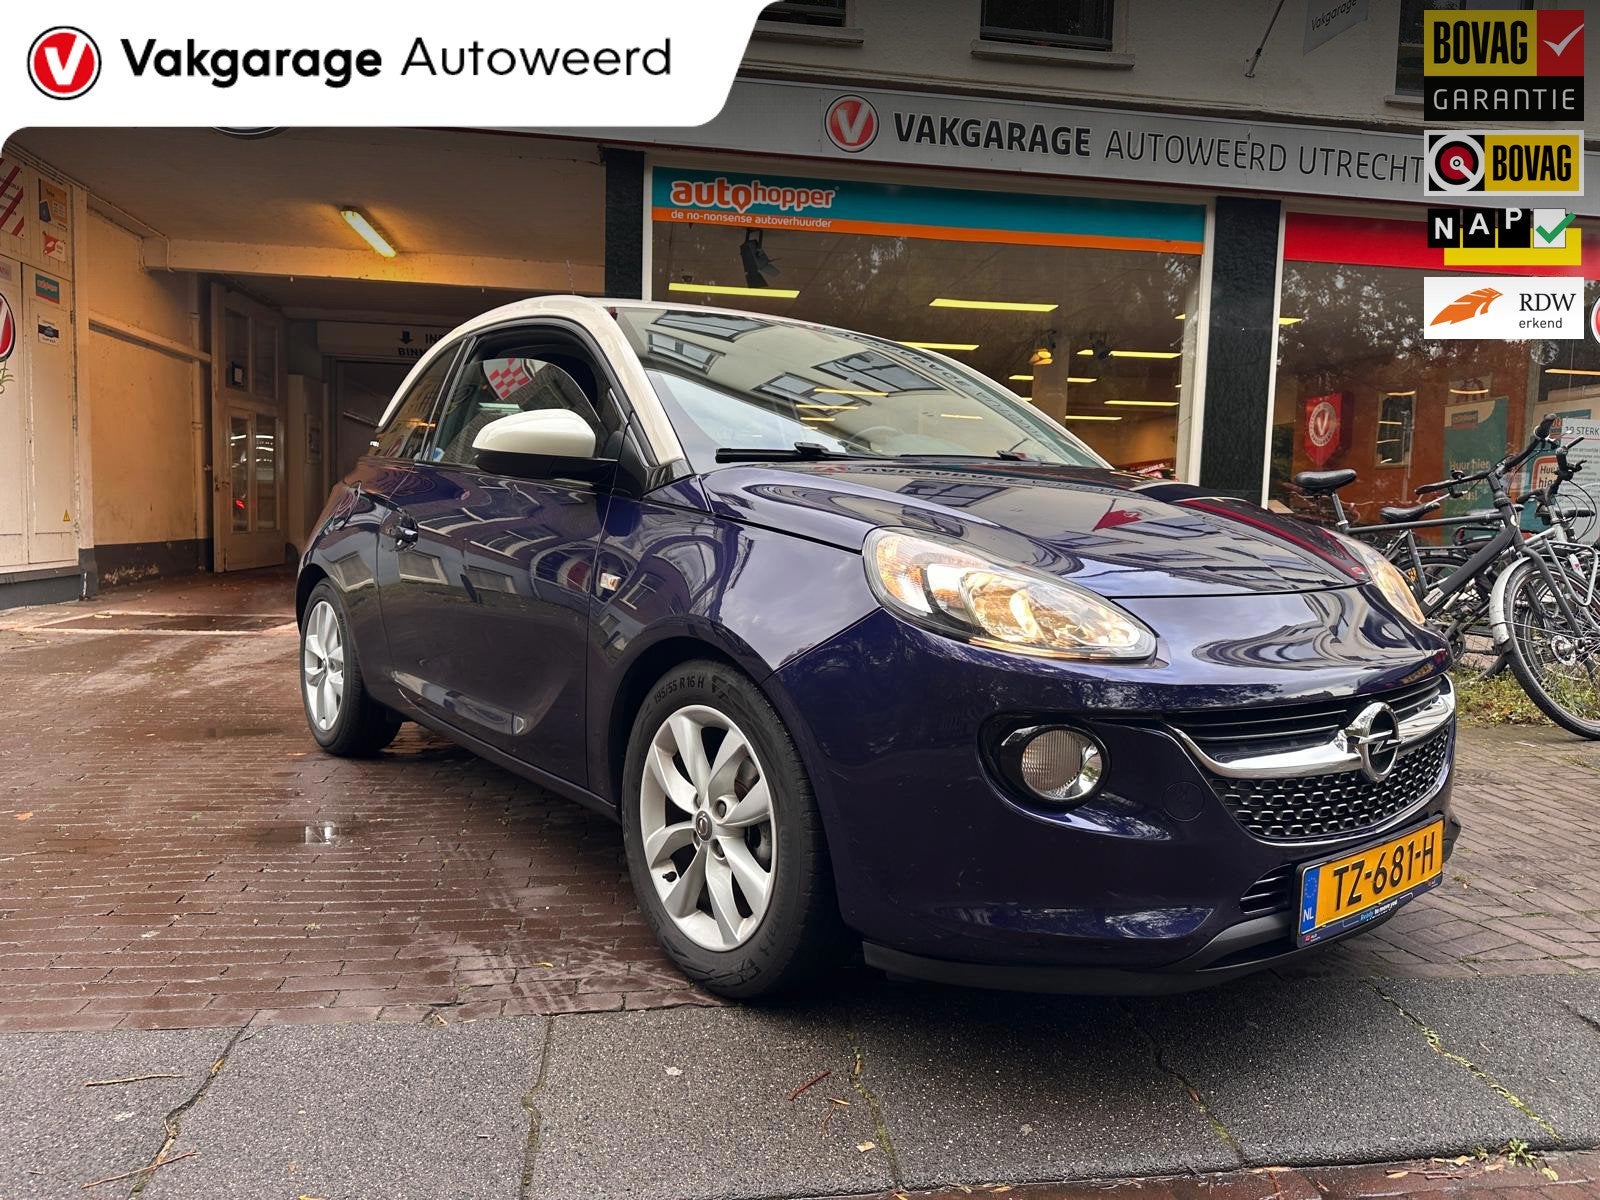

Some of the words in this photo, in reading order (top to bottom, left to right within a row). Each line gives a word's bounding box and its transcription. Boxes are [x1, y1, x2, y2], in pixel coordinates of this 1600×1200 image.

[1311, 0, 1357, 31] Vakgarage
[893, 112, 1091, 157] VAKGARAGE
[1105, 130, 1287, 172] AUTOWEERD
[1299, 146, 1424, 184] UTRECHT
[671, 178, 835, 212] autohopper
[671, 209, 684, 219] de
[687, 212, 752, 223] no-nonsense
[755, 216, 832, 228] autoverhuurder
[654, 680, 678, 704] 195/55
[687, 676, 696, 688] 16
[1333, 831, 1435, 911] TZ-681-H
[1303, 908, 1314, 922] NL
